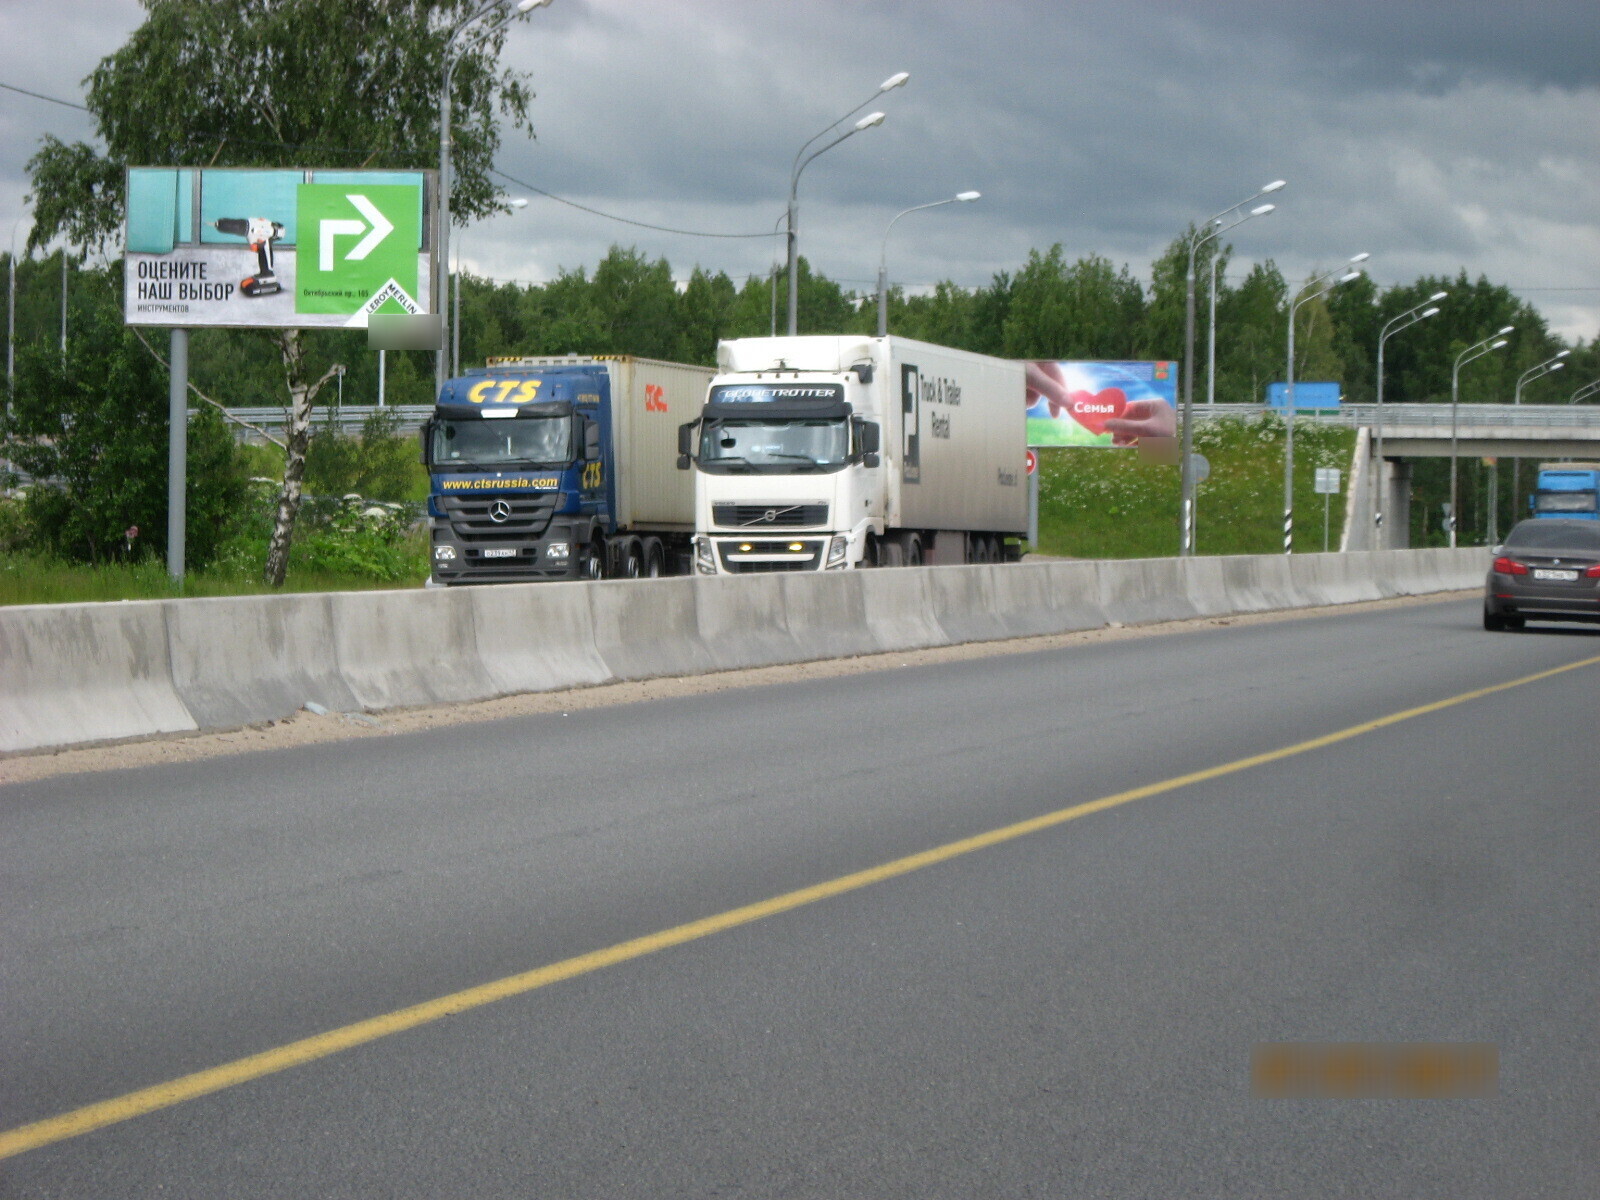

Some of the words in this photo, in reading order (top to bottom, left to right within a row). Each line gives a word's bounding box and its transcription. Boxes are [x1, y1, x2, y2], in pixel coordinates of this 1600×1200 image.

[138, 261, 207, 281] ОЦЕНИТЕ
[138, 282, 172, 300] НАШ
[179, 283, 234, 301] ВЫБОР
[365, 289, 390, 314] LEROY
[387, 283, 418, 315] MERLIN
[137, 304, 189, 313] ИНСТРУМЕНТОВ
[468, 380, 541, 402] CTS
[1074, 401, 1115, 413] Семья
[931, 410, 950, 439] Rental
[443, 478, 558, 489] www.ctsrussia.com
[582, 461, 602, 490] CTS
